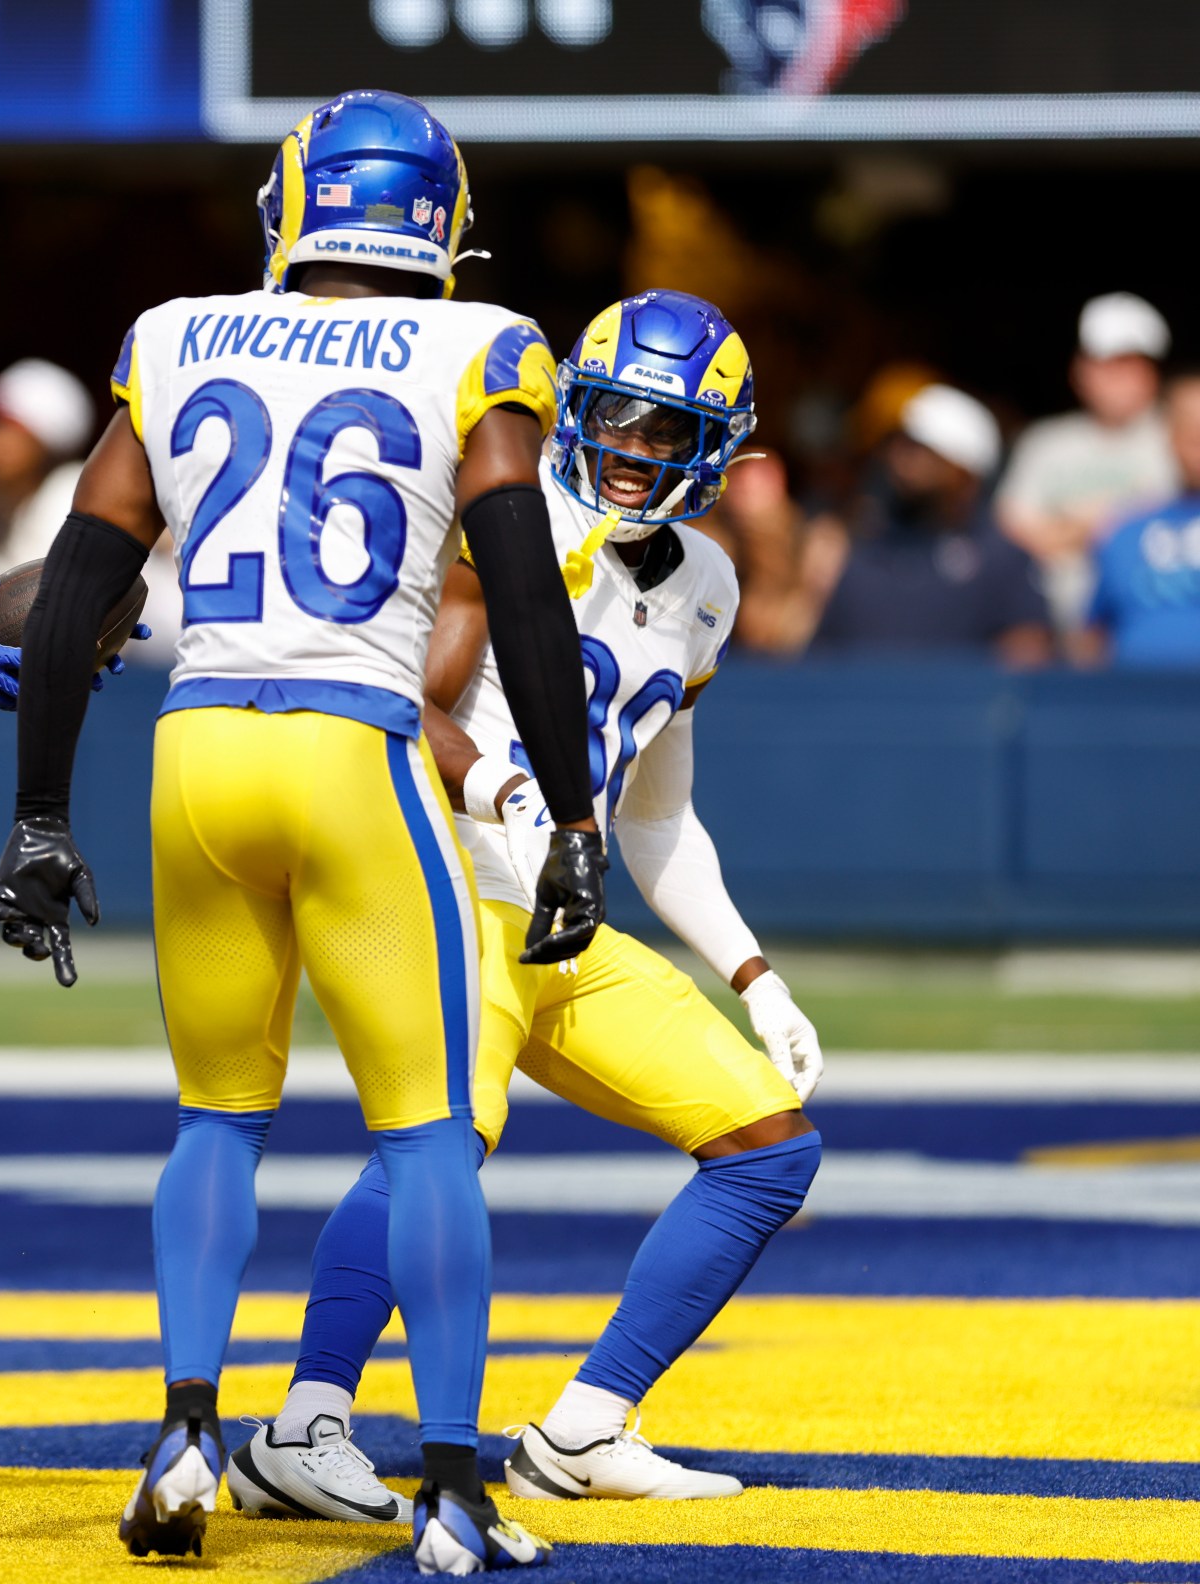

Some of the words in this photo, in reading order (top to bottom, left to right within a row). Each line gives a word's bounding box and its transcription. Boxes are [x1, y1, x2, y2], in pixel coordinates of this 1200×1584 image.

[314, 240, 352, 252] LOS
[355, 243, 438, 263] ANGELES
[178, 314, 419, 372] KINCHENS
[634, 367, 674, 385] RAMS
[170, 377, 422, 628] 26
